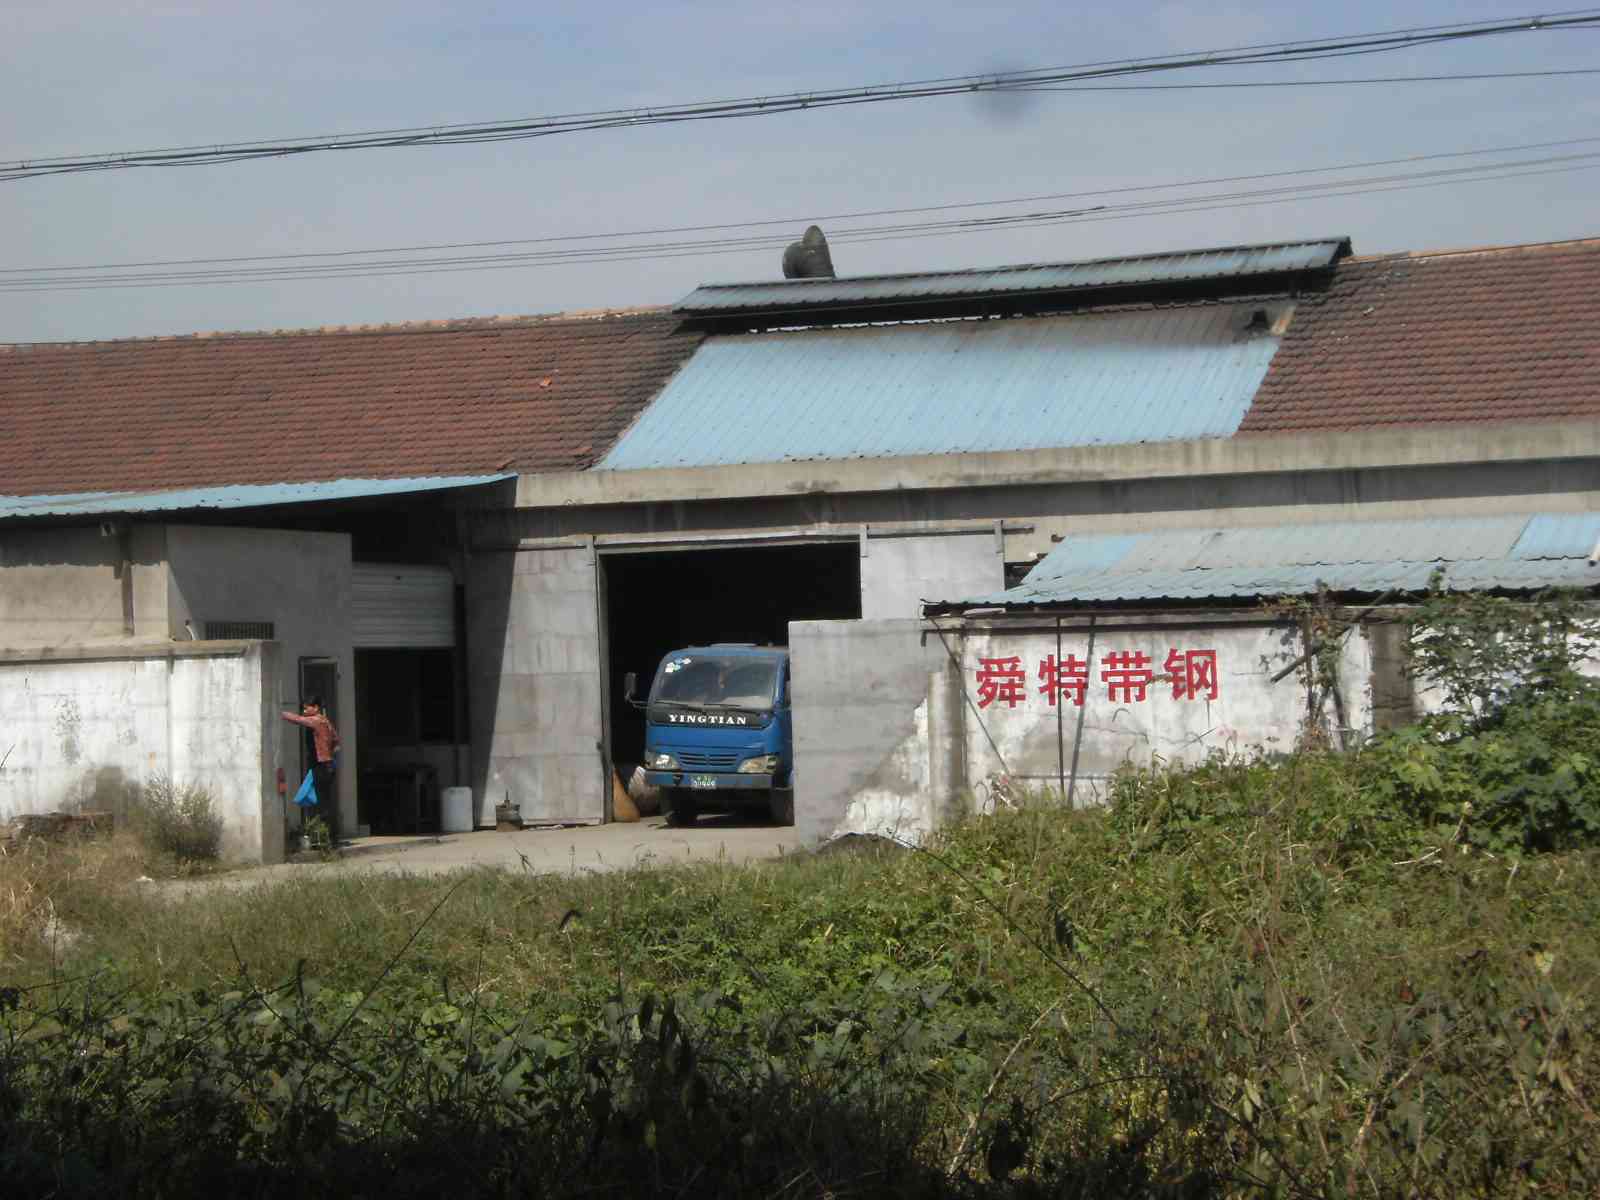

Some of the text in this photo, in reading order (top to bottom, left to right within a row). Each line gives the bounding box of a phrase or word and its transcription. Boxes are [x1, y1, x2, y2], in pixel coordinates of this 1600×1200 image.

[975, 648, 1219, 709] 舜特带钢
[668, 714, 747, 725] YINGTIAN
